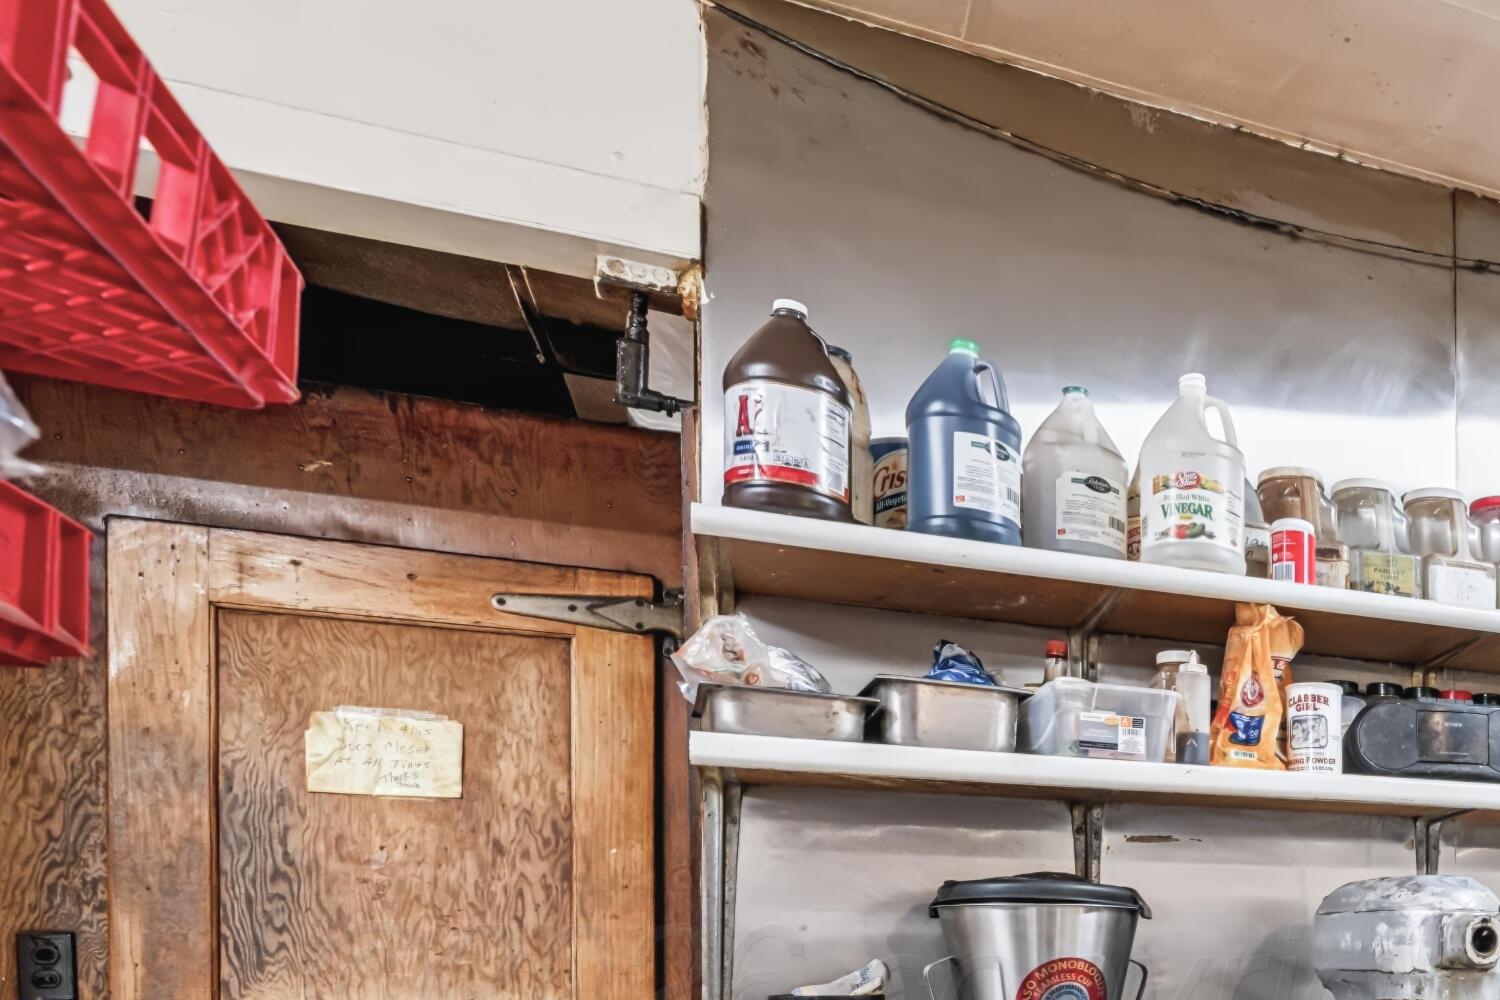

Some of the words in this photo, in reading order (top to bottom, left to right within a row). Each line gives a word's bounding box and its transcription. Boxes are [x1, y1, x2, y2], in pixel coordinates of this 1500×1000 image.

[874, 466, 907, 499] Cris
[875, 494, 907, 513] All-Veget
[1161, 502, 1213, 521] VINEGAR
[1288, 694, 1330, 707] CLABBER
[1034, 960, 1105, 997] MONOBLOQUE
